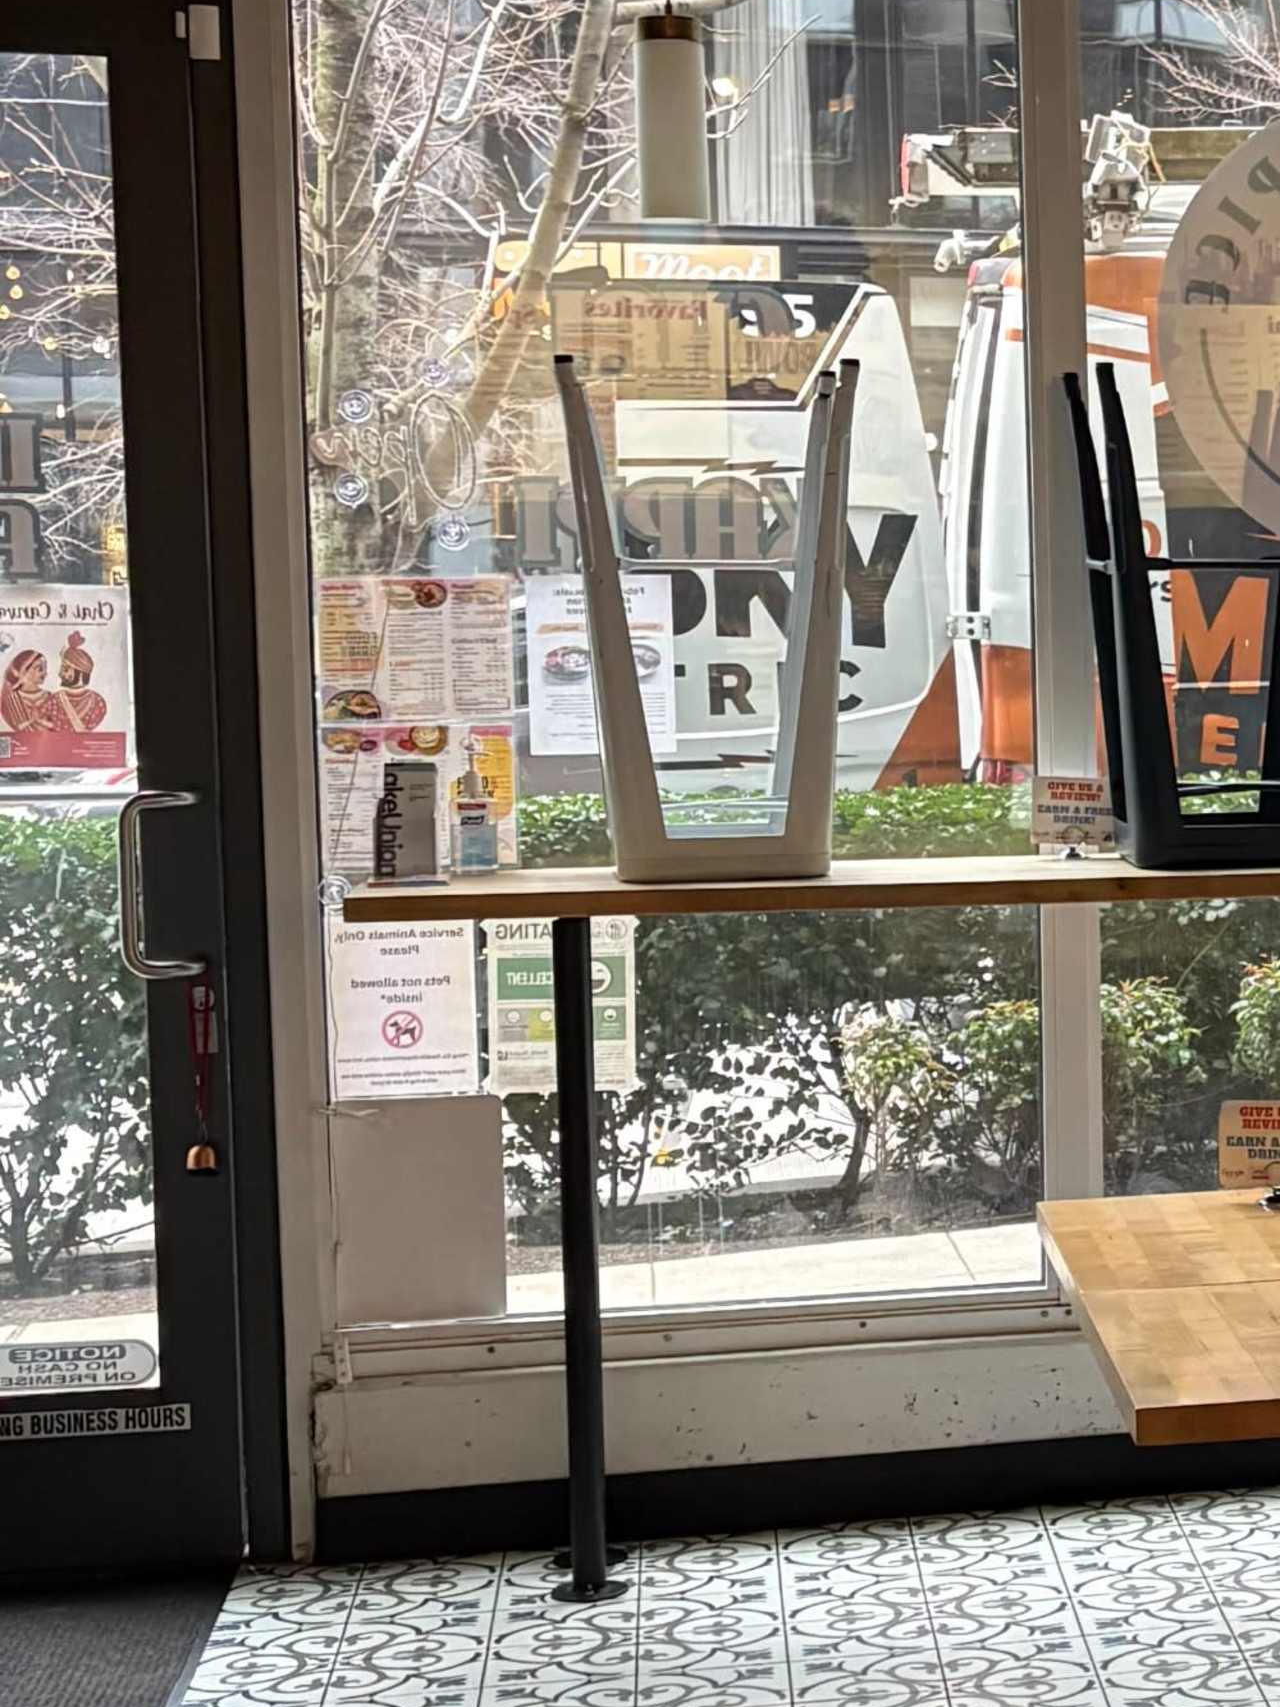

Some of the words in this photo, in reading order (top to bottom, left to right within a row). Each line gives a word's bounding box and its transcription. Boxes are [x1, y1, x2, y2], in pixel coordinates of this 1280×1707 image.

[1240, 1106, 1273, 1118] GIVE
[1226, 1136, 1267, 1147] EARN
[1271, 1137, 1280, 1147] A
[30, 1409, 119, 1435] BUSINESS
[125, 1406, 186, 1430] HOURS
